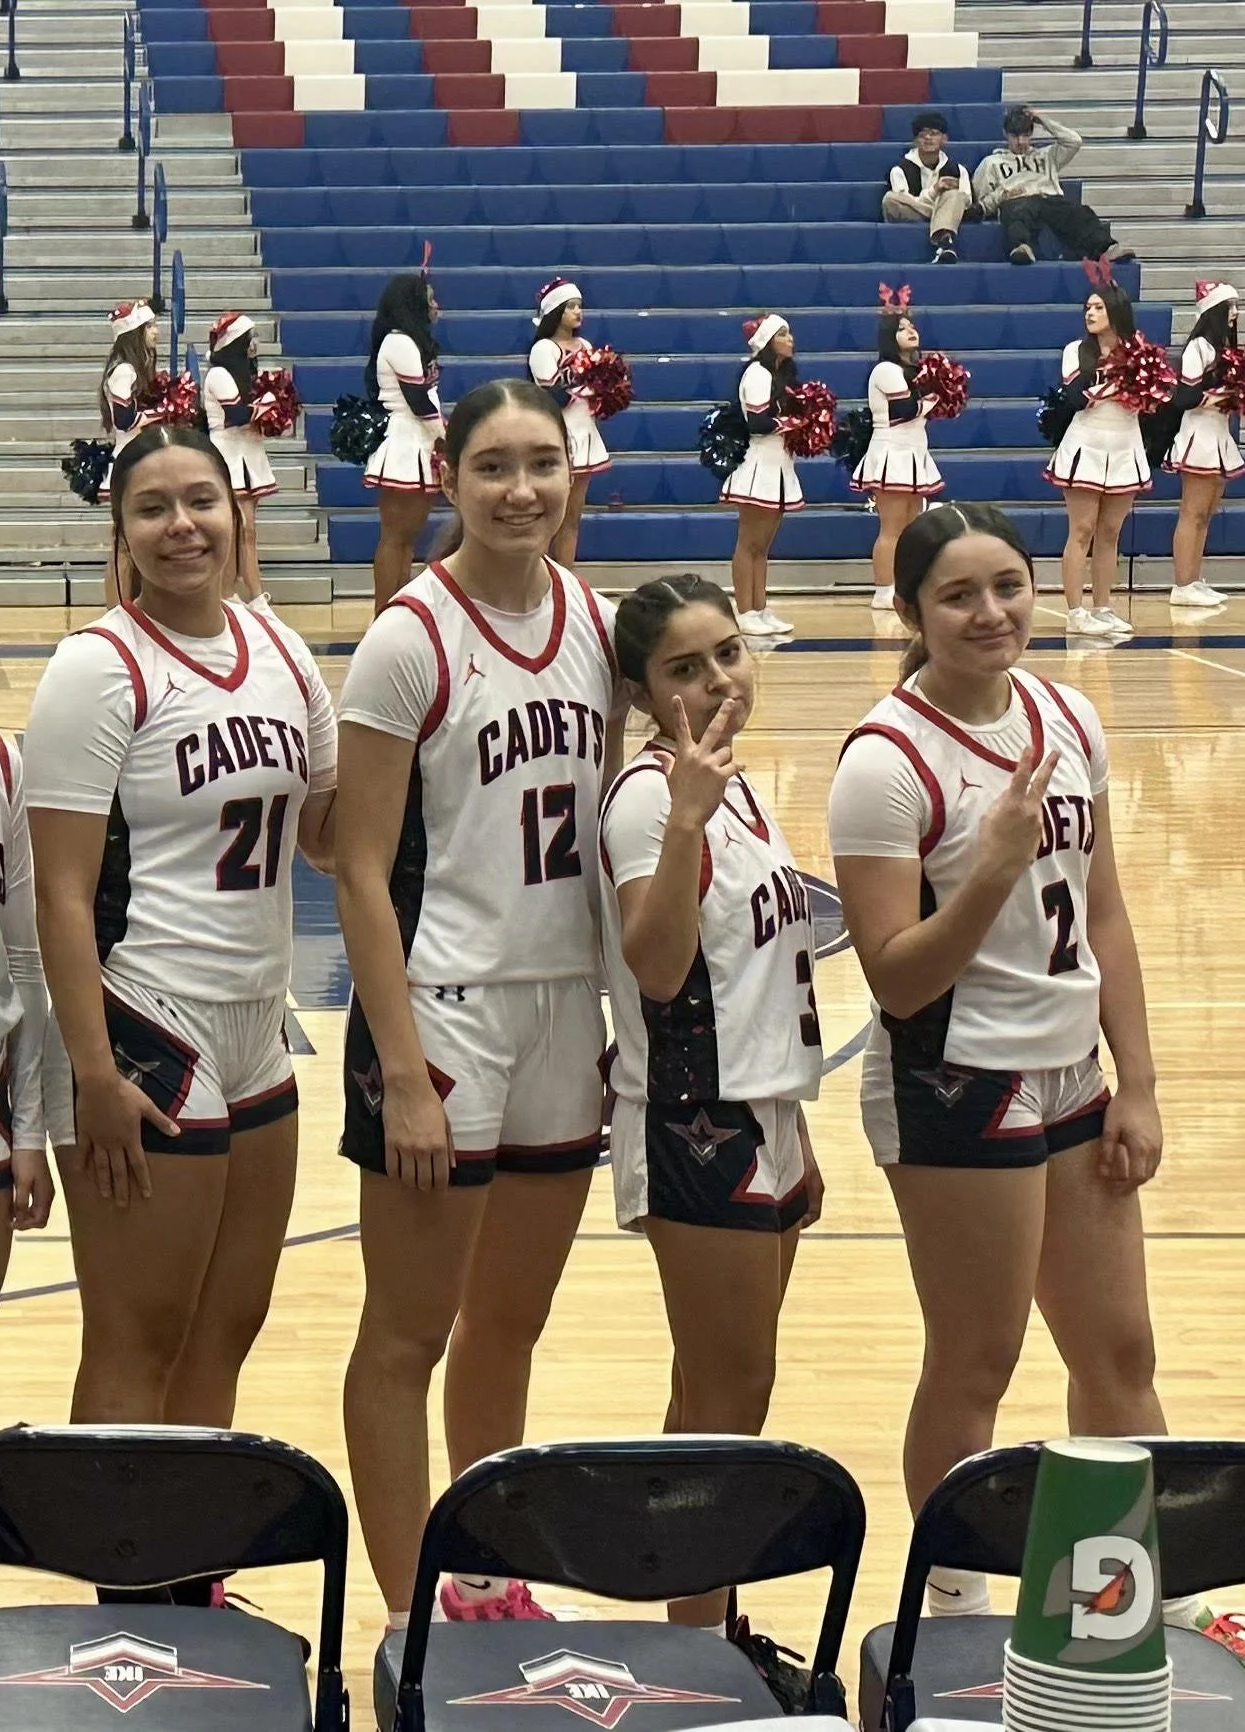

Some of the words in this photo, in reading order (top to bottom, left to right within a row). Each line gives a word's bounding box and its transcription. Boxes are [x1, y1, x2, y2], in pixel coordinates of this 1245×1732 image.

[175, 715, 308, 797] CADETS
[477, 698, 604, 785] CADETS
[216, 794, 288, 891] 21
[520, 781, 582, 886] 12
[1041, 878, 1080, 977] 2
[103, 1665, 144, 1682] IKE
[564, 1683, 610, 1699] IKE
